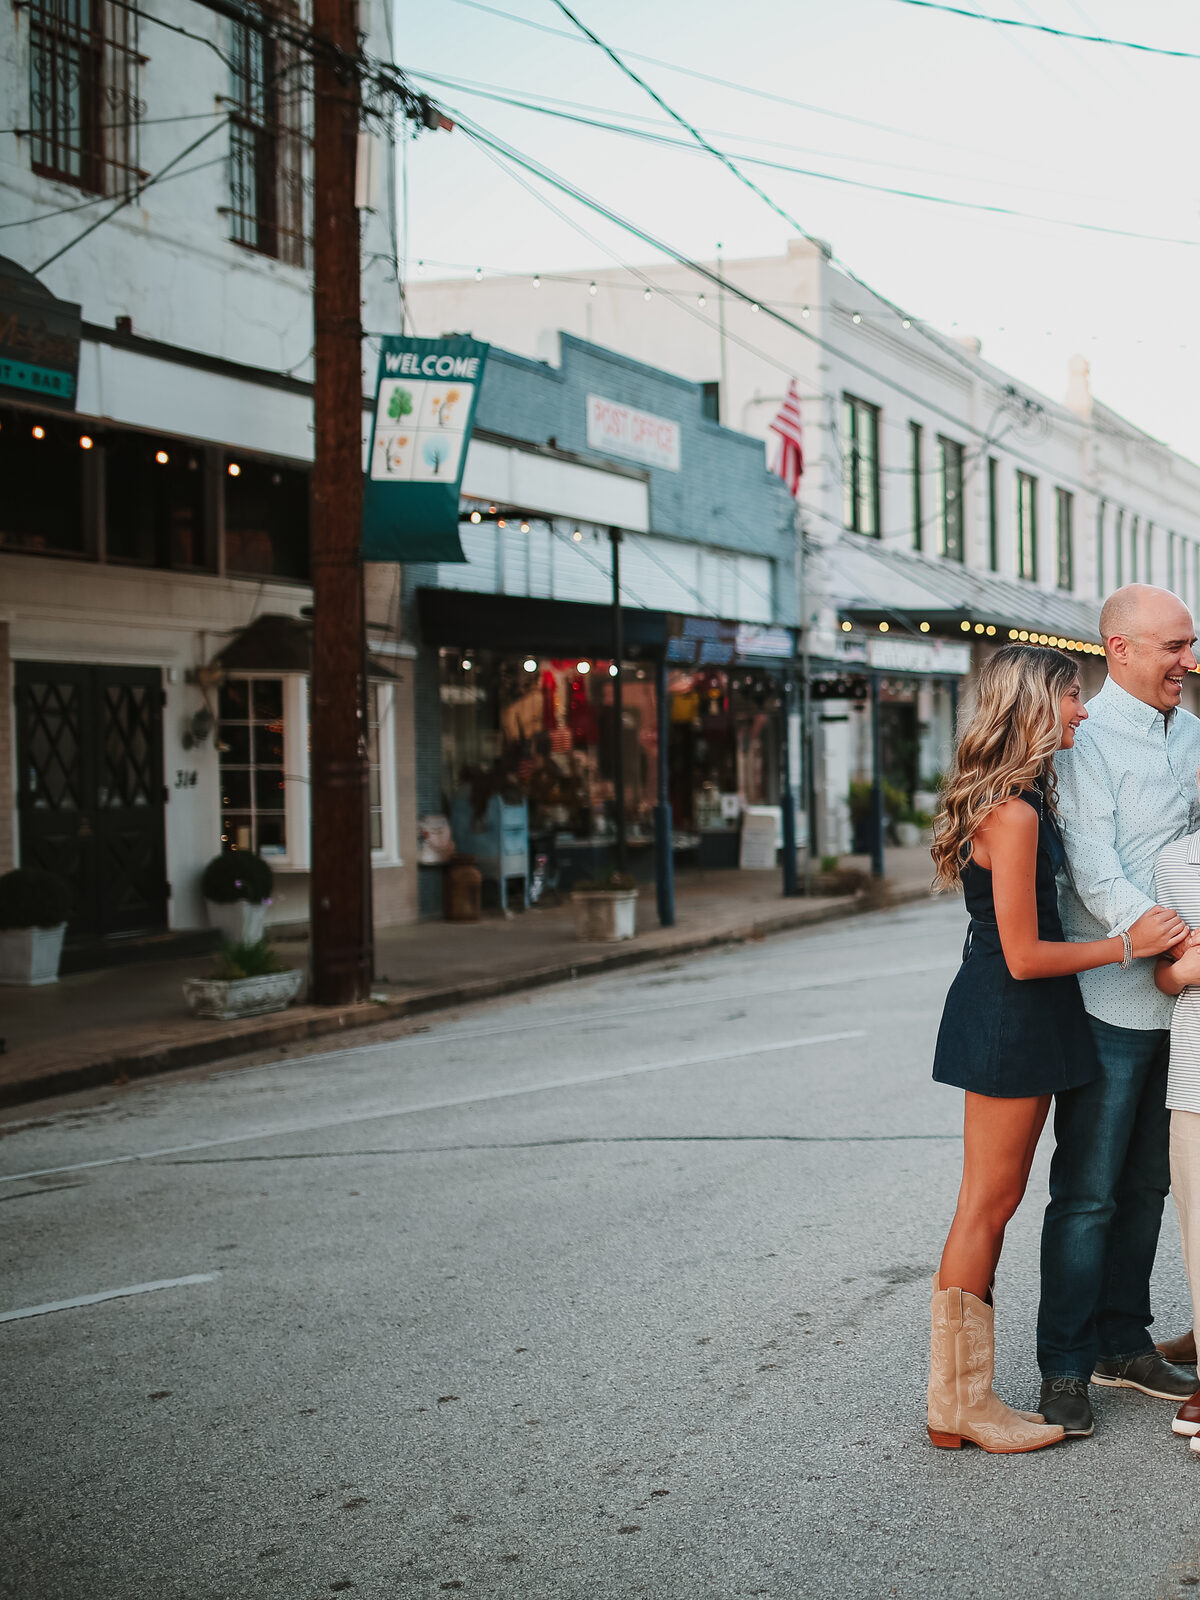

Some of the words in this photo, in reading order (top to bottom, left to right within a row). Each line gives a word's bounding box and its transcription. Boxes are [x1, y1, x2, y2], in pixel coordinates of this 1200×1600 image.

[385, 351, 480, 379] WELCOME
[31, 371, 62, 390] BAR
[594, 402, 629, 437] POST
[631, 415, 674, 455] OFFICE
